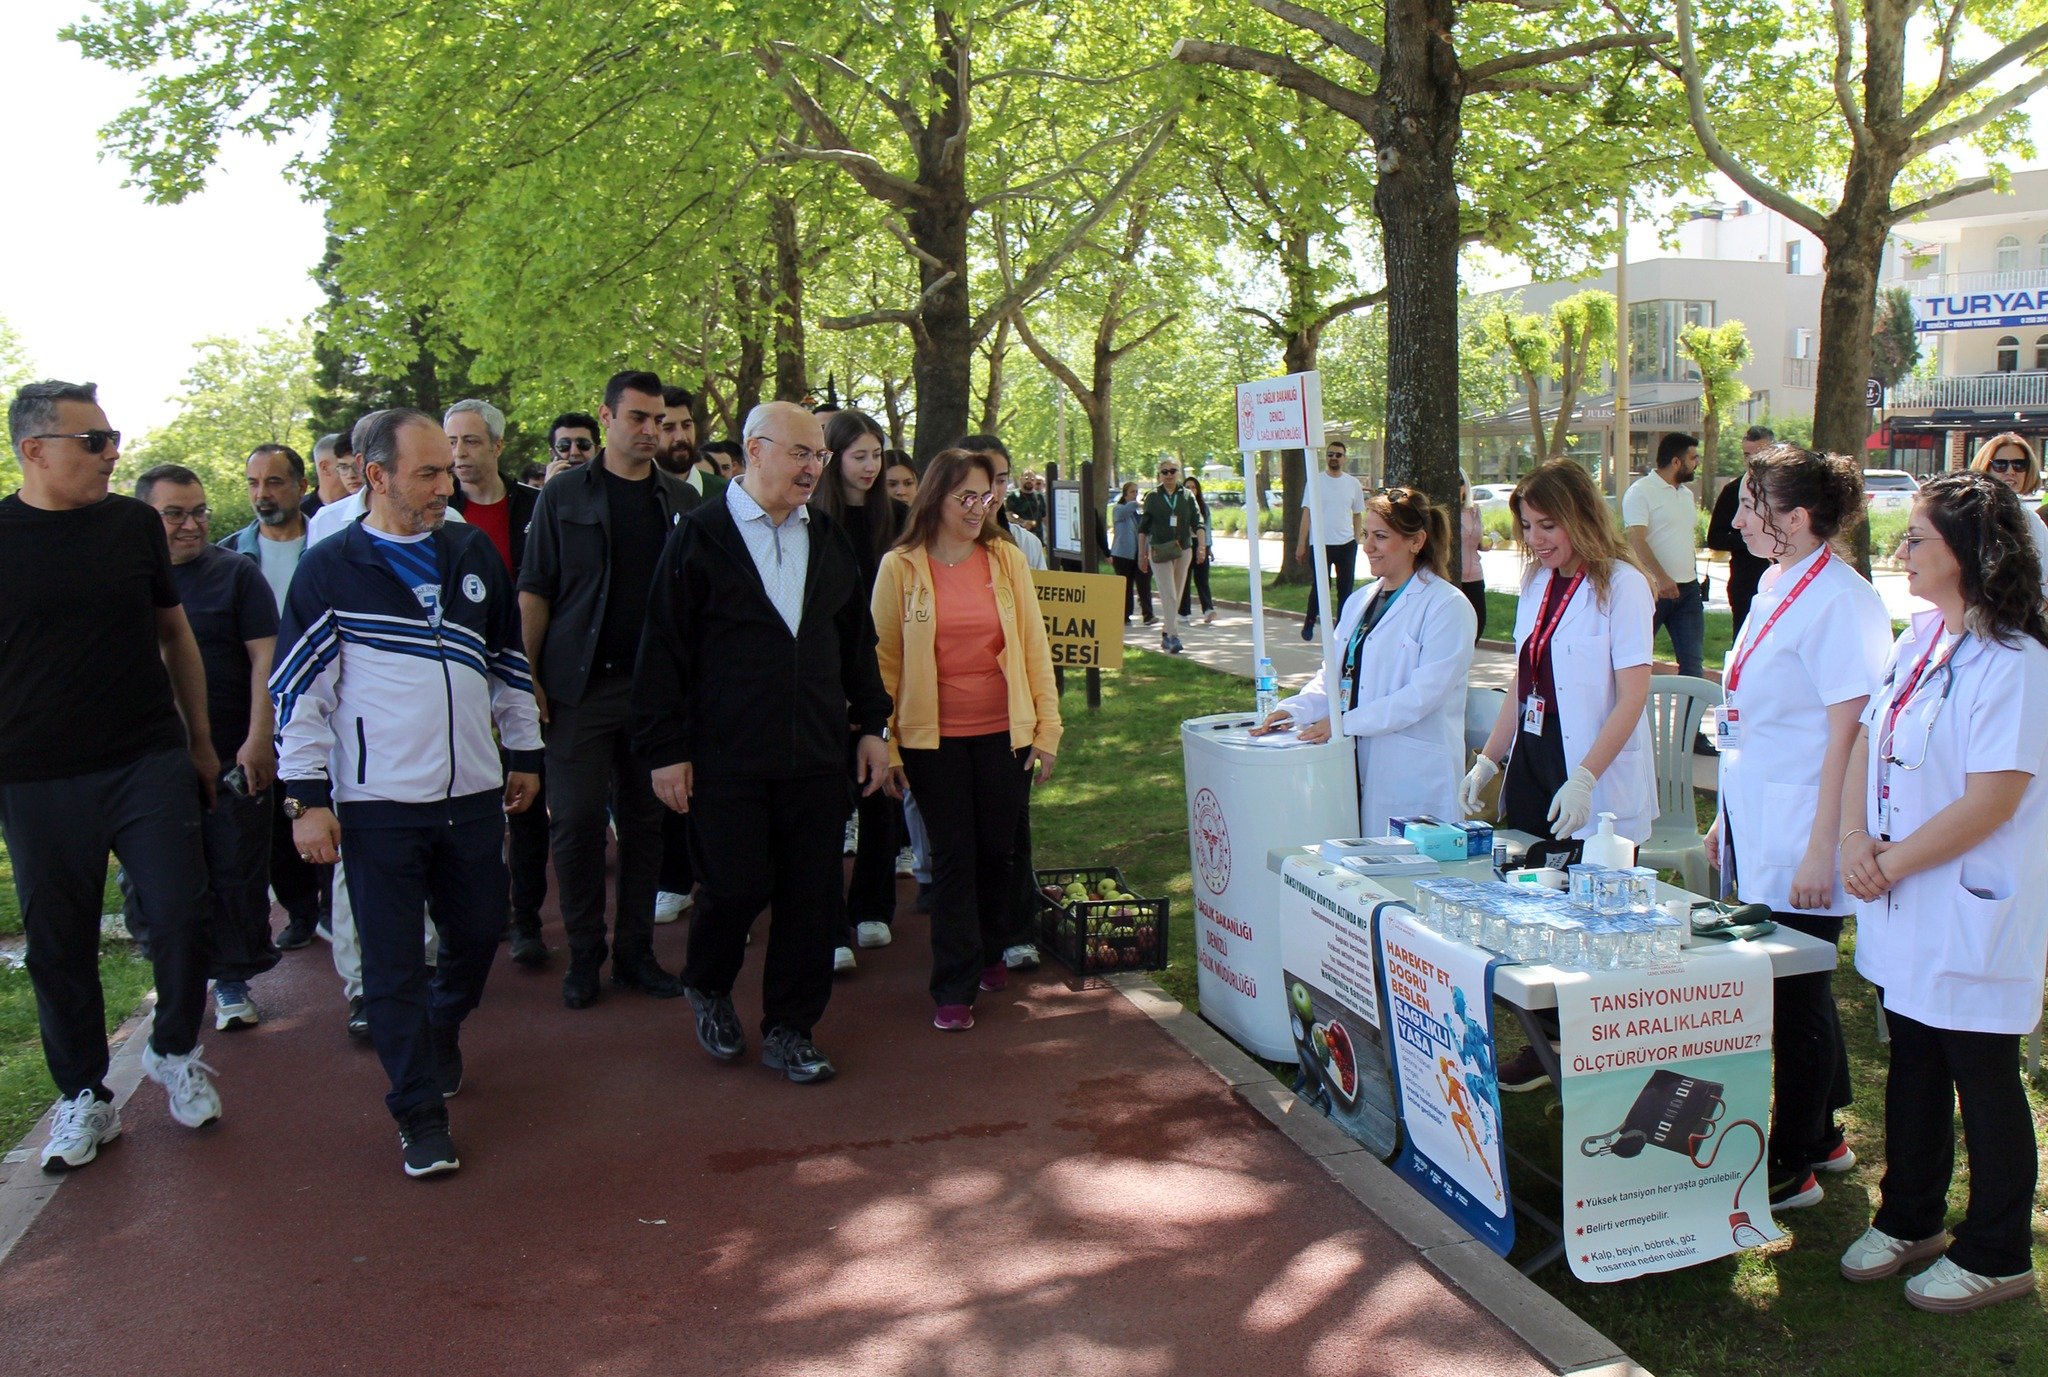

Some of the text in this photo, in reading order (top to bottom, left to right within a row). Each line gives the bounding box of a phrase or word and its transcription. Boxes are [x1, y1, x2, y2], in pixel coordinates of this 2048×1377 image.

[1263, 389, 1276, 404] SAĞLIK
[1276, 386, 1298, 402] BAKANLIĞI
[1269, 409, 1285, 423] DENİZLİ
[1585, 409, 1612, 418] JULES
[1261, 428, 1274, 441] SAĞLIK
[1274, 425, 1302, 440] MÜDÜRLÜĞÜ
[1034, 585, 1086, 604] ZEFENDİ
[1048, 636, 1099, 665] SESİ
[1198, 897, 1215, 922] SAĞLIK
[1215, 910, 1253, 942] BAKANLIĞI
[1317, 894, 1337, 914] KONTROL
[1337, 905, 1356, 926] ALTINDA
[1206, 930, 1228, 956] DENİZLİ
[1386, 939, 1434, 979] HAREKET
[1214, 959, 1256, 999] MÜDÜRLÜĞÜ
[1391, 977, 1434, 1018] BESLEN,
[1590, 981, 1744, 1013] TANSİYONUNUZU
[1591, 1008, 1744, 1041] SIK ARALIKLARLA
[1573, 1034, 1761, 1073] ÖLÇTÜRÜYOR MUSUNUZ?
[1585, 1170, 1743, 1208] Yüksek tansiyon her yaşta görülebilir.
[1586, 1210, 1670, 1235] Belirti vermeyebilir.
[1590, 1234, 1697, 1264] Kalp, beyin, böbrek, göz
[1595, 1246, 1700, 1274] hasarına neden olabilir.
